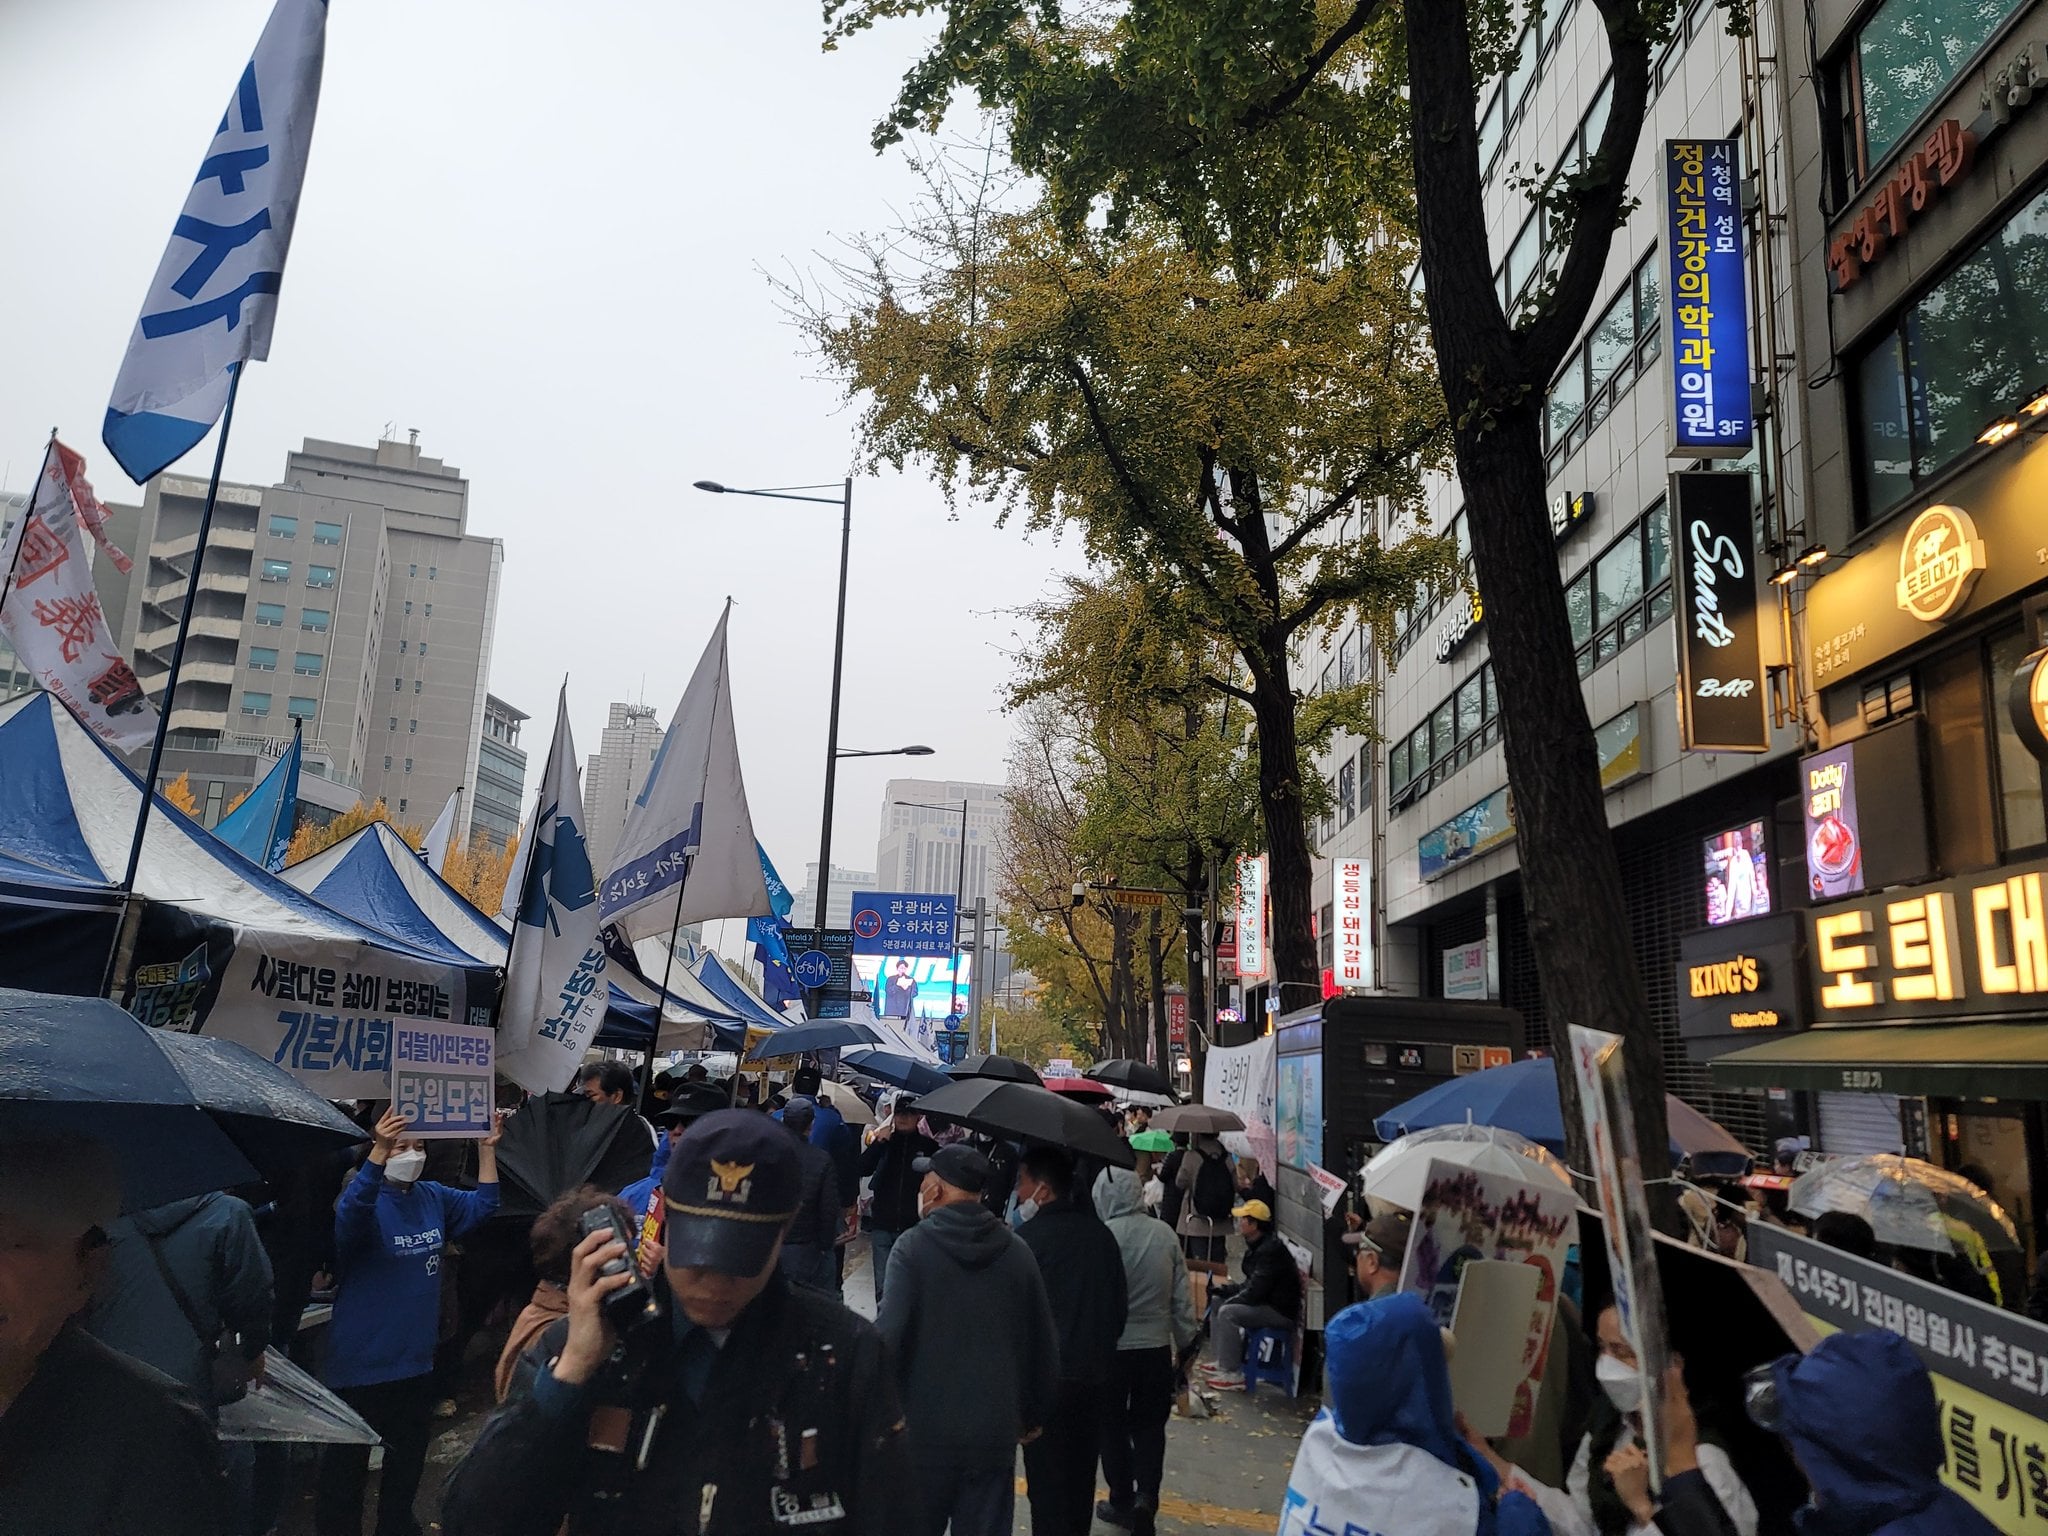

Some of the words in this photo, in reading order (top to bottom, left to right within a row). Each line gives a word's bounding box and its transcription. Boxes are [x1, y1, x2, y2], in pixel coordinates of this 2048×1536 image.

[1711, 145, 1731, 206] 시청역
[1828, 120, 1964, 289] 삼성리빙텔
[1714, 215, 1736, 253] 성모
[1673, 144, 1716, 437] 정신건강의학과의원
[1718, 420, 1744, 436] 3F
[1696, 678, 1755, 698] BAR
[887, 918, 950, 934] 승·하차장
[890, 900, 948, 915] 관광버스
[822, 934, 847, 942] Unfold
[251, 954, 337, 1008] 사람다운
[342, 972, 381, 1012] 삶이
[384, 976, 450, 1020] 보장되는
[1689, 954, 1759, 998] KING'S
[274, 1010, 392, 1071] 기본사회
[398, 1030, 491, 1067] 더불어민주당
[400, 1077, 489, 1123] 당원모집
[393, 1227, 442, 1248] 파란고양이
[1938, 1399, 1983, 1493] 를
